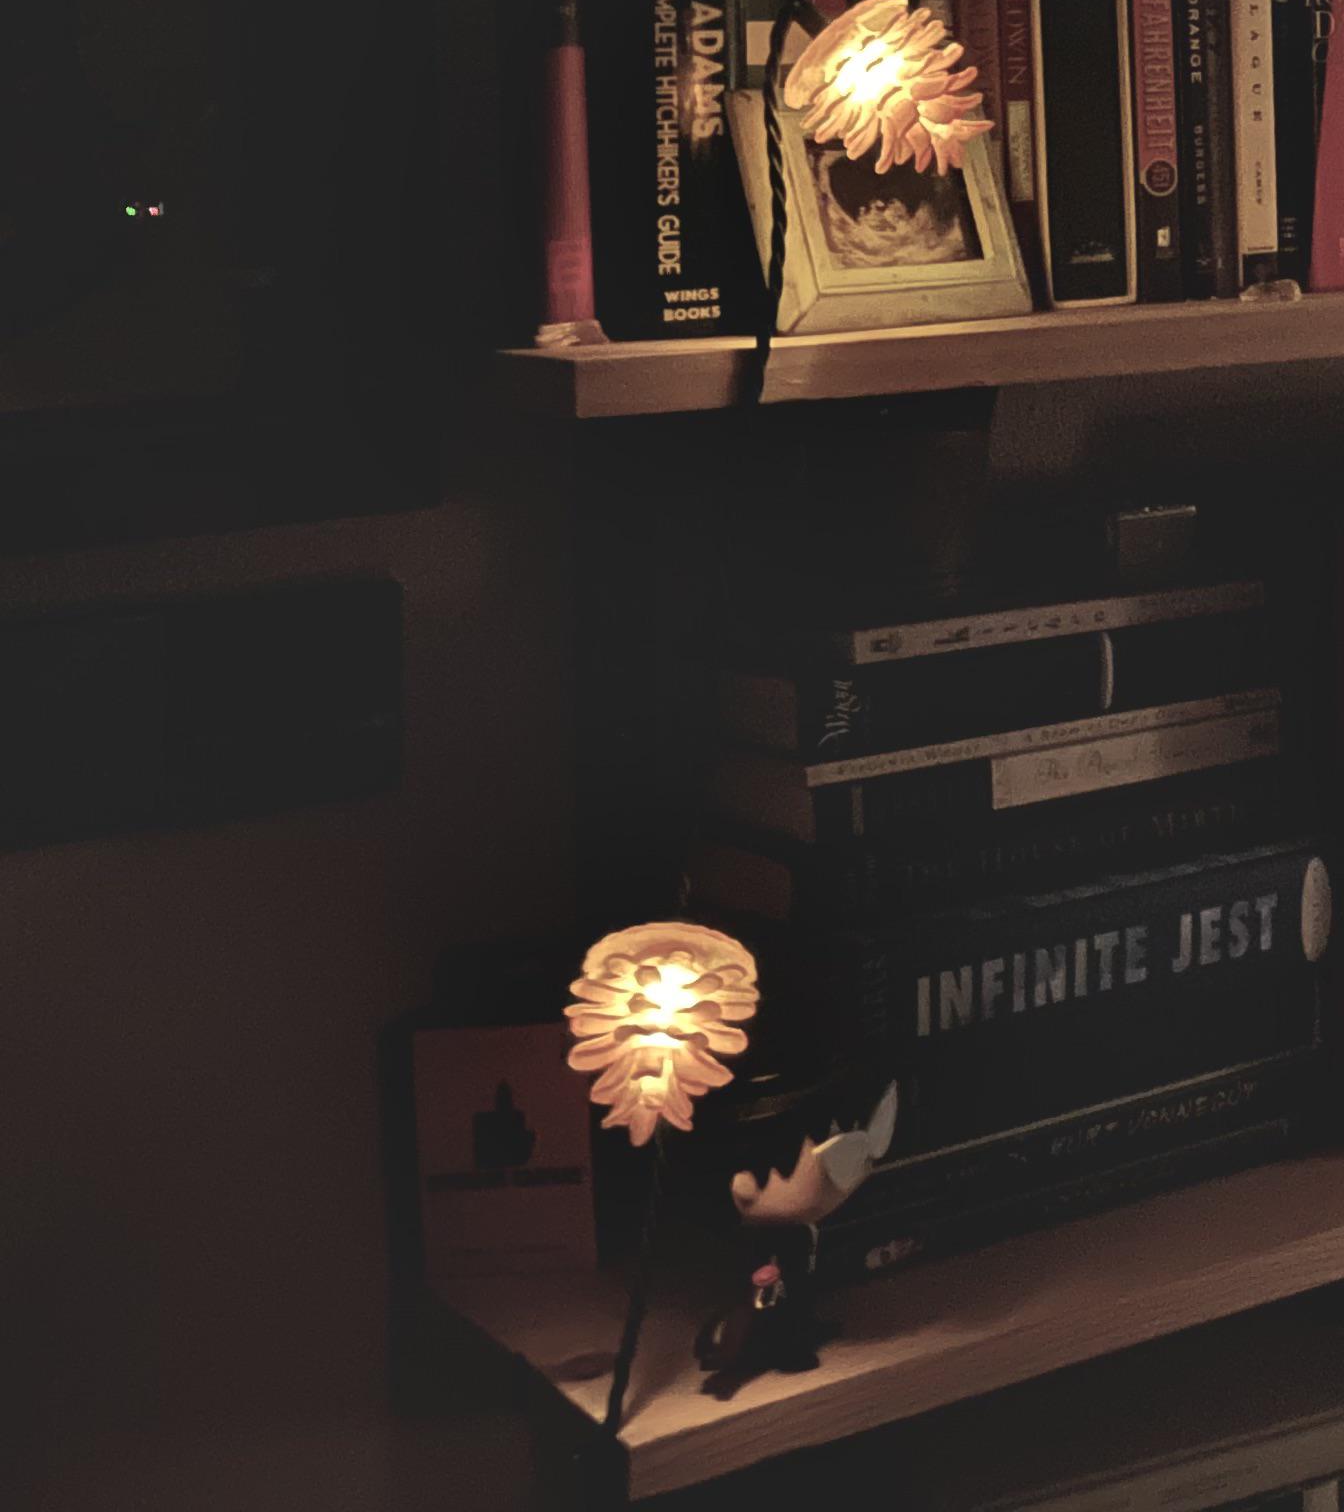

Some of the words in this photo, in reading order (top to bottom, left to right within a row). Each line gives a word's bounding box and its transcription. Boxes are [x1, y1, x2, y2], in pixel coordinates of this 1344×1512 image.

[690, 0, 726, 142] ADAMS
[656, 74, 681, 207] HITCHHIKER'S
[657, 213, 682, 276] GUIDE
[662, 304, 721, 322] BOOKS
[663, 286, 720, 304] WINGS
[915, 924, 1149, 1037] INFINITE
[1170, 892, 1280, 974] JEST
